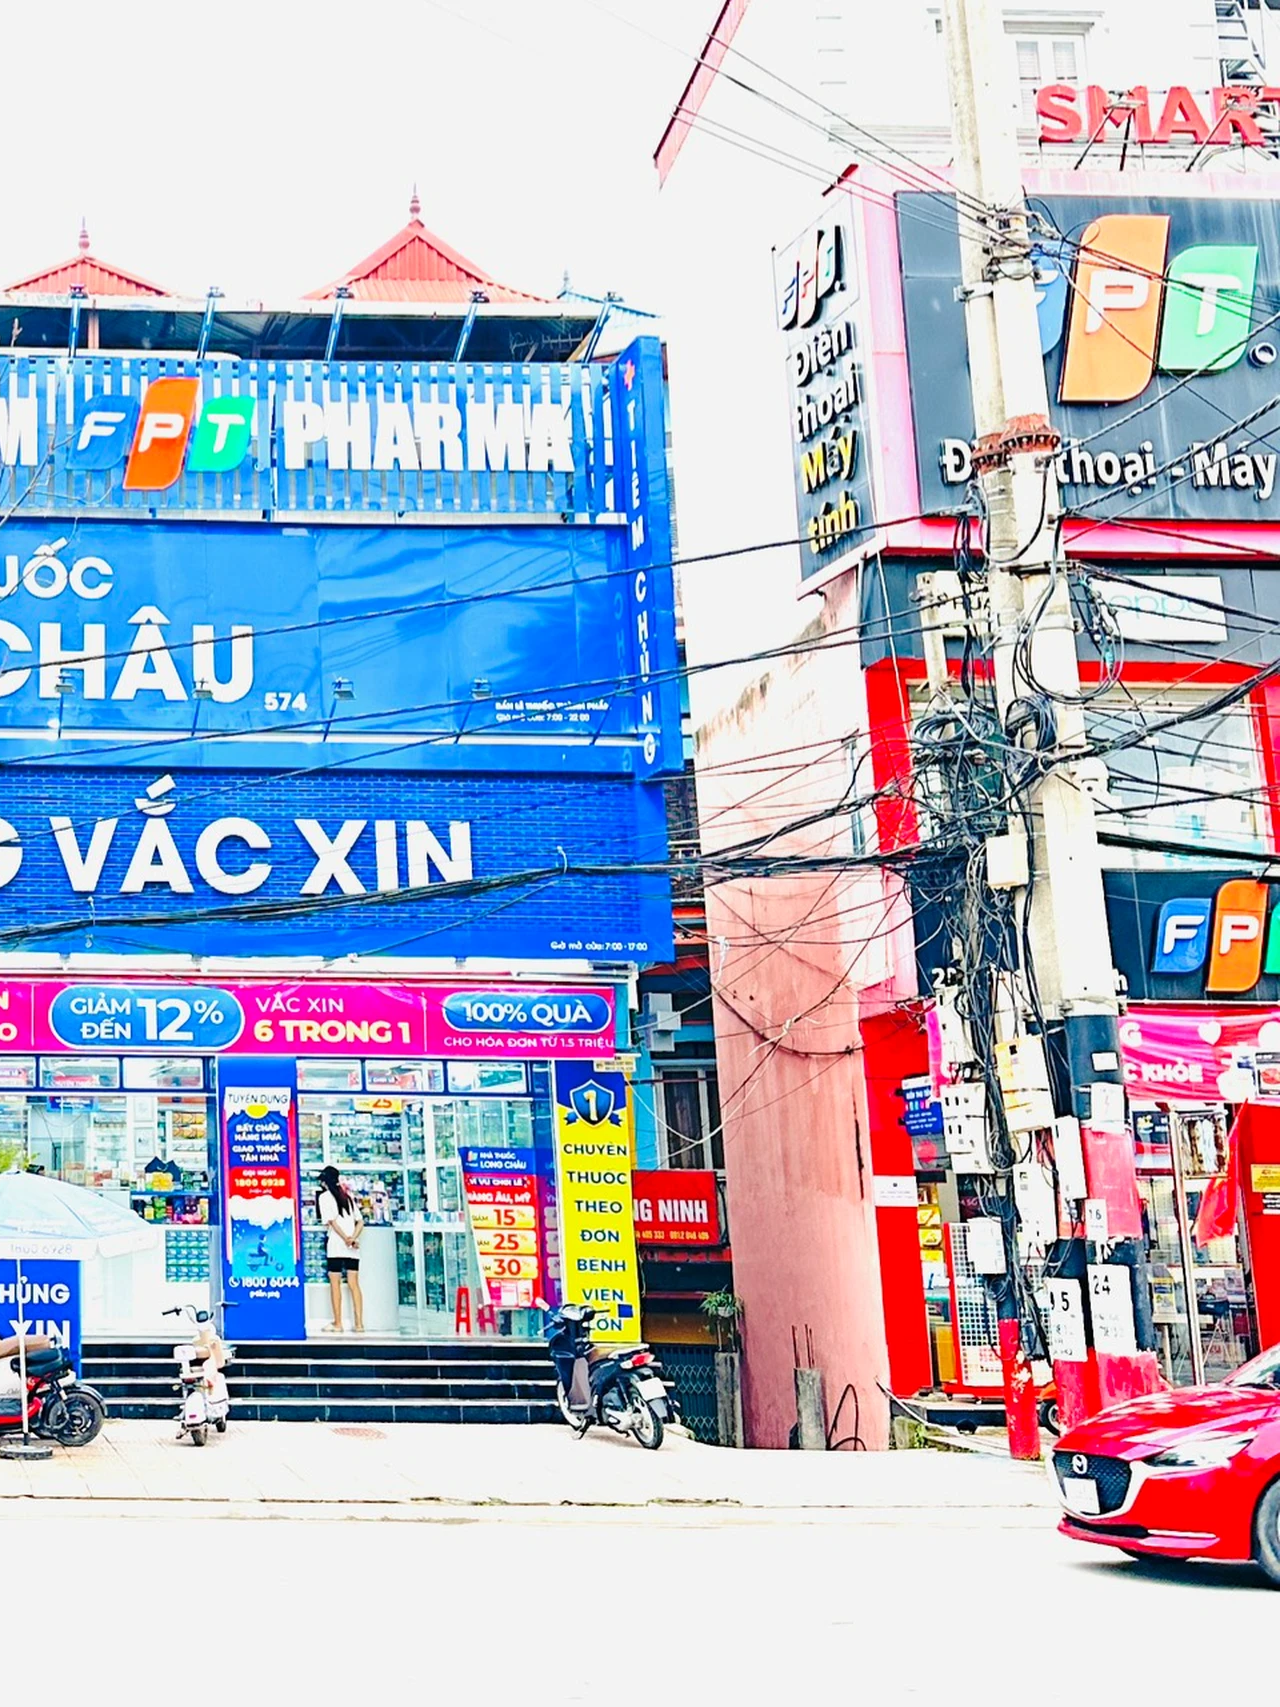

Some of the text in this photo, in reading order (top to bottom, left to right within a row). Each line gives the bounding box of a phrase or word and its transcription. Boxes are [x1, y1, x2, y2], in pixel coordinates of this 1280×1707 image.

[1036, 84, 1280, 145] SMAR
[283, 402, 575, 472] PHARMA
[801, 426, 856, 493] Máy
[1191, 440, 1278, 500] Máy
[807, 491, 857, 554] tính
[264, 692, 308, 713] 574
[49, 774, 275, 895] VẮC
[293, 817, 477, 896] XIN
[308, 996, 345, 1013] XIN
[463, 998, 594, 1025] 100% QUÀ
[70, 993, 225, 1042] GIẢM 12%
[80, 1017, 132, 1040] ĐẾN
[254, 1019, 411, 1044] 6 TRONG 1
[444, 1036, 472, 1048] CHO
[561, 1036, 575, 1048] 1.5
[583, 1089, 598, 1121] 1
[234, 1178, 259, 1187] 1800
[574, 1199, 623, 1214] THEO
[657, 1199, 709, 1223] NINH
[240, 1276, 301, 1288] 1800 6044
[1093, 1275, 1111, 1296] 24
